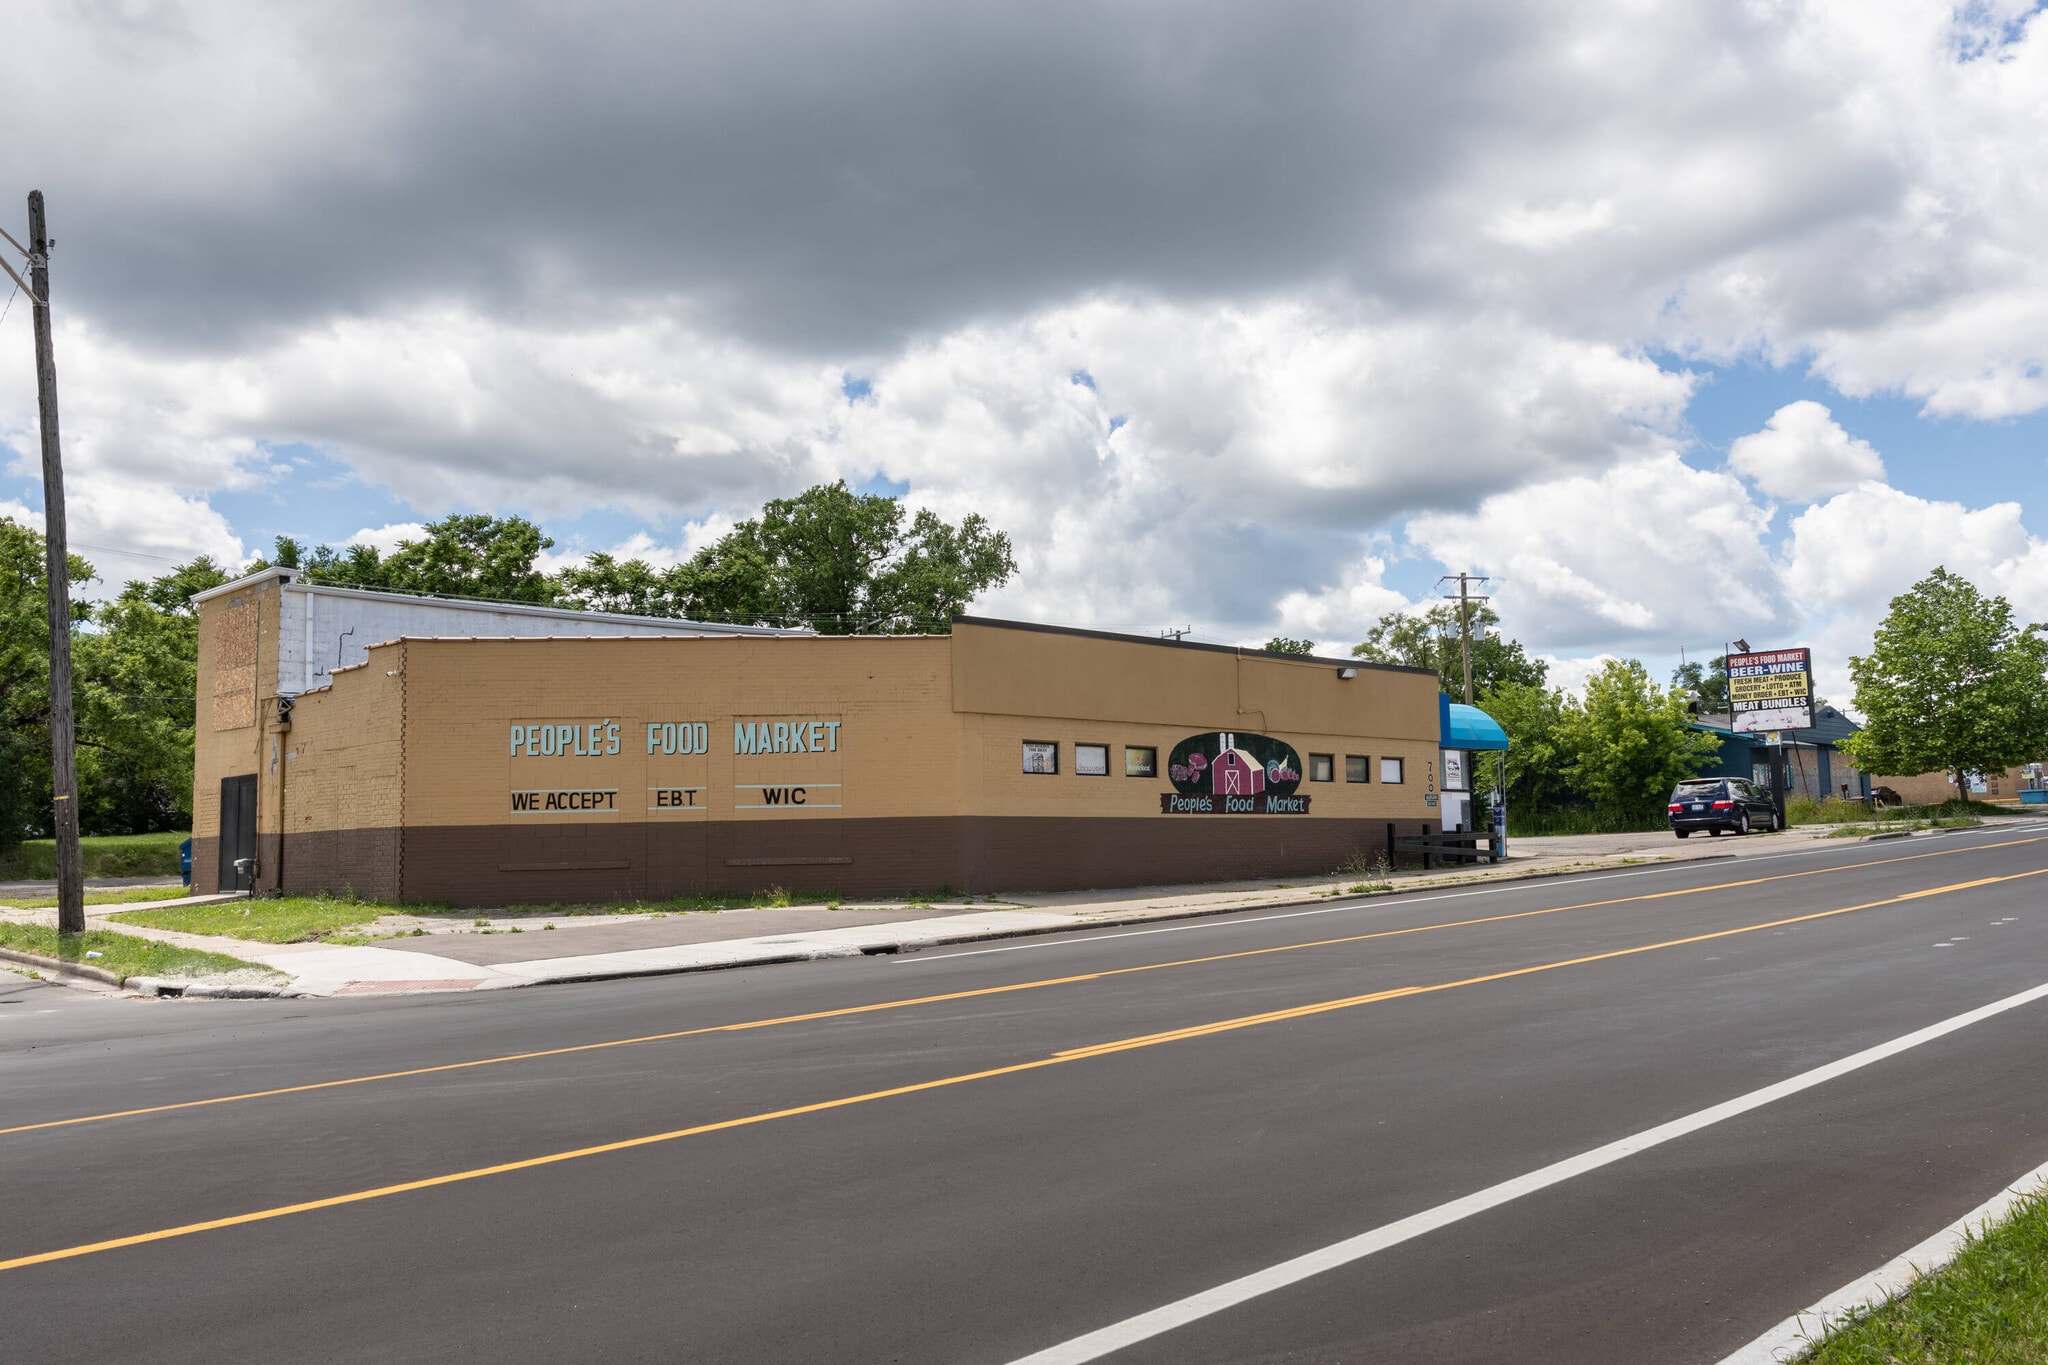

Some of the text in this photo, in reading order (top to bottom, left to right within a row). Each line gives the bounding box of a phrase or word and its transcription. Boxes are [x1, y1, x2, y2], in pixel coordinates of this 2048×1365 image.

[1730, 652, 1803, 667] PEOPLE'S FOOD MARKET
[1731, 662, 1804, 677] BEER-WINE
[1734, 677, 1752, 685] FRESH
[1774, 673, 1802, 681] PRODUCE
[1766, 682, 1783, 690] LOTTO
[1732, 692, 1752, 700] MONEY
[1753, 691, 1772, 699] ORDER
[1793, 688, 1806, 696] WIC
[1733, 697, 1807, 712] MEAT BUNDLES
[510, 718, 842, 757] PEOPLE'S FOOD MARKET
[512, 792, 539, 811] WE
[545, 791, 617, 811] ACCEPT
[762, 787, 806, 805] WIC
[1170, 794, 1305, 814] People's Food Market
